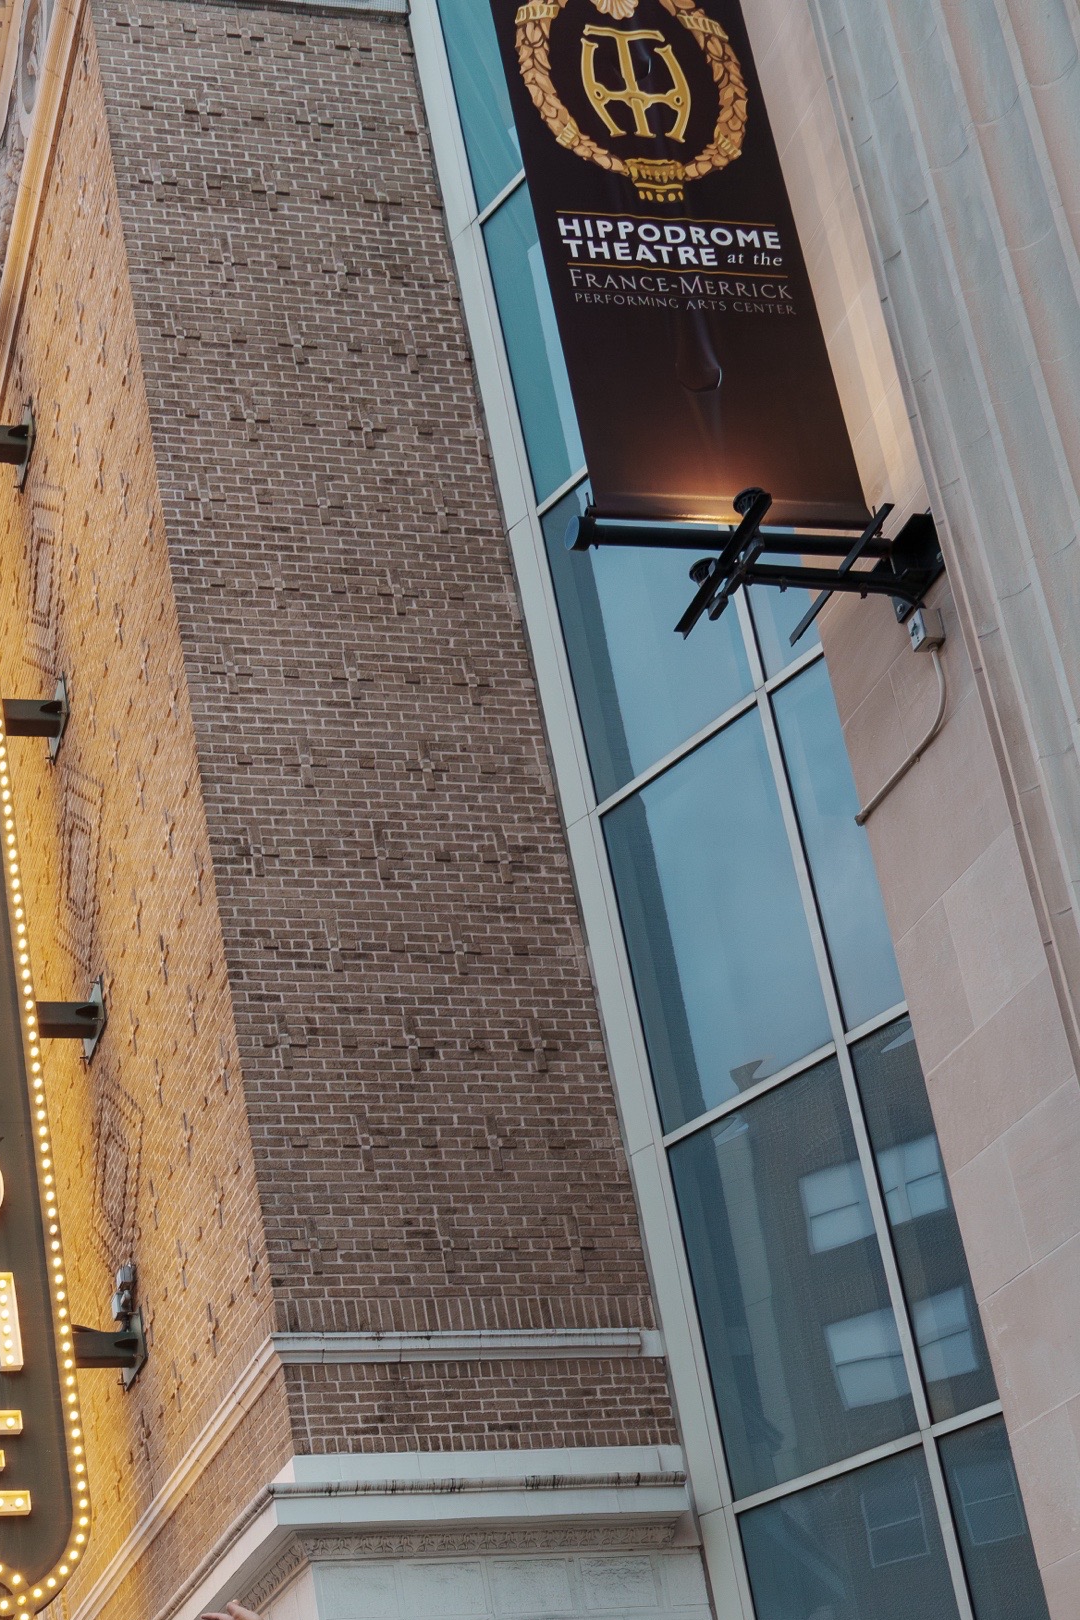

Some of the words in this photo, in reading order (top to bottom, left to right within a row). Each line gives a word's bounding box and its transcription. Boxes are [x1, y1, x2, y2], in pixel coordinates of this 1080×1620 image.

[557, 218, 782, 250] HIPPODROME
[562, 239, 718, 267] THEATRE
[727, 253, 745, 265] at
[754, 254, 783, 266] the
[574, 292, 679, 310] PERFORMING
[686, 299, 727, 312] ARTS
[733, 301, 797, 316] CENTER
